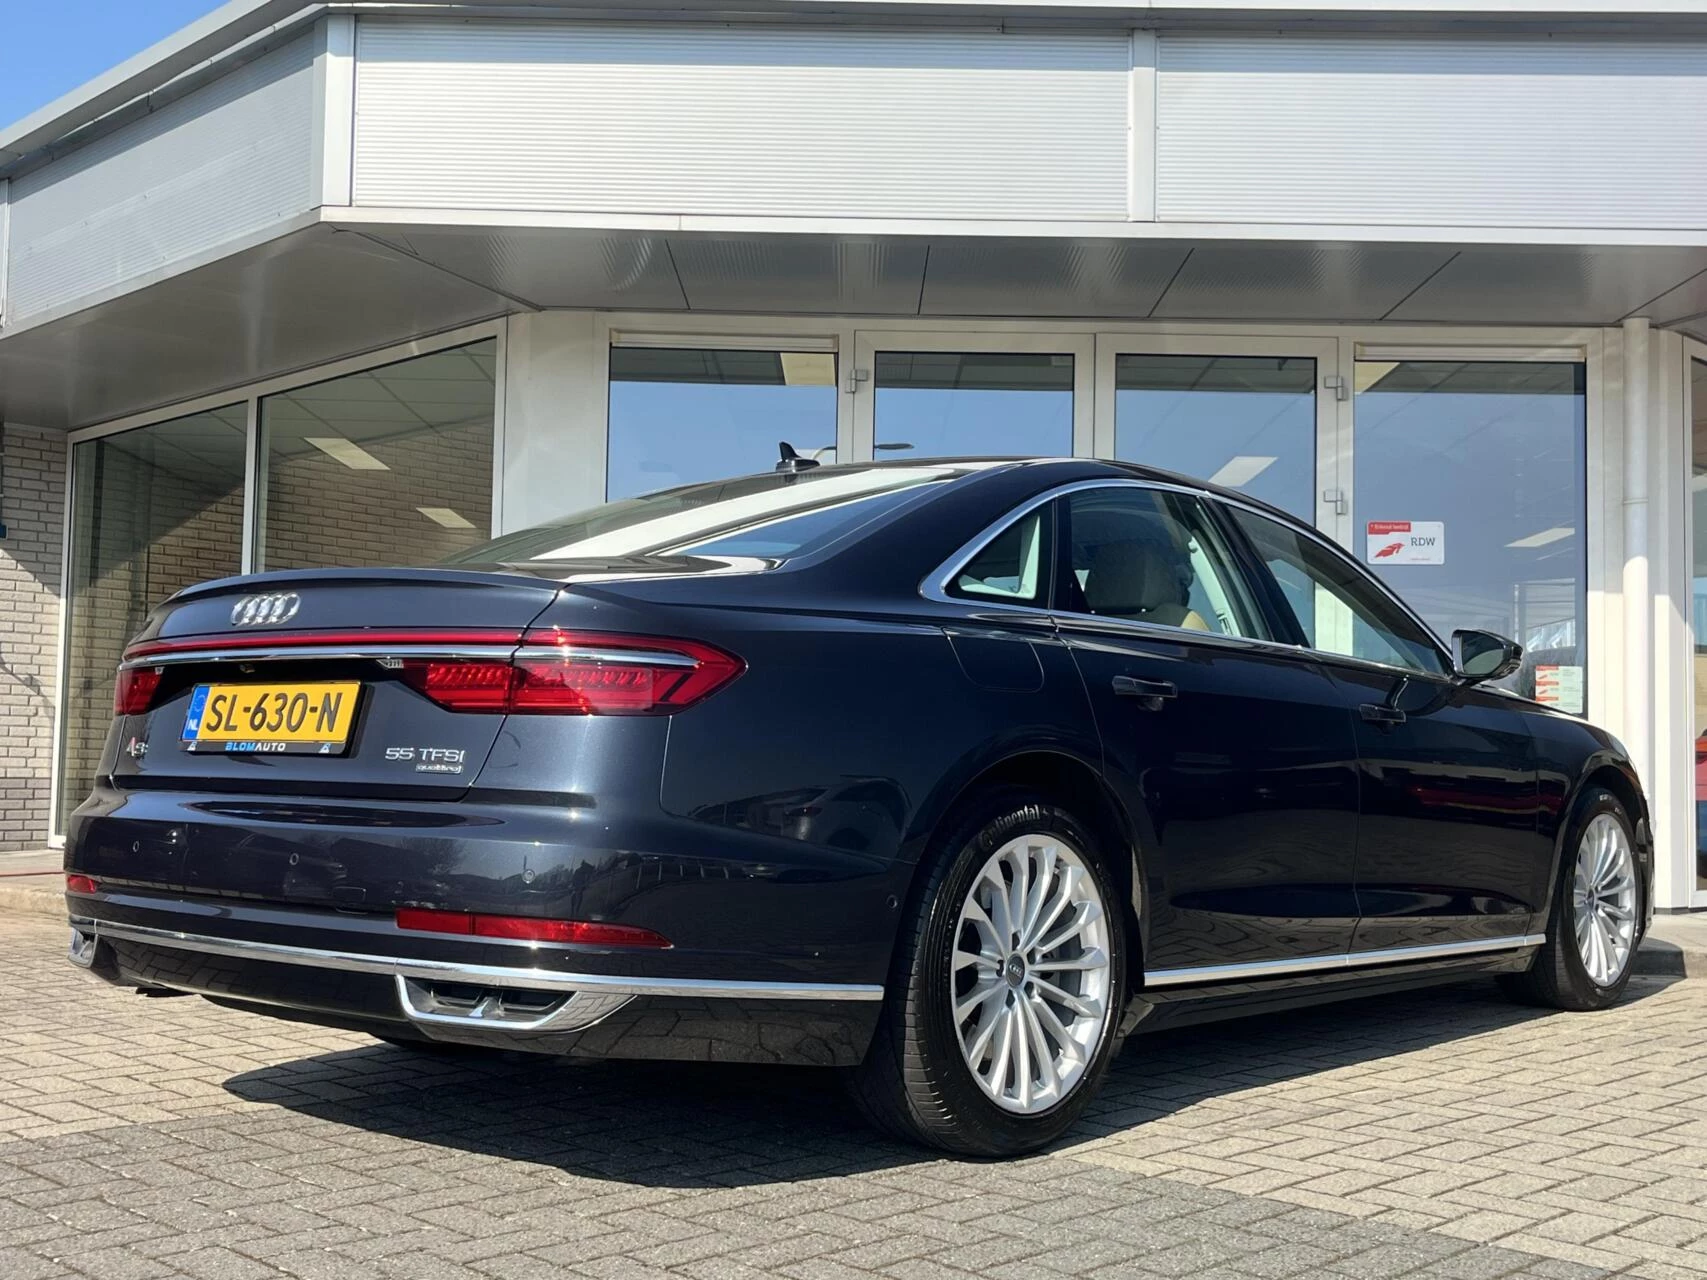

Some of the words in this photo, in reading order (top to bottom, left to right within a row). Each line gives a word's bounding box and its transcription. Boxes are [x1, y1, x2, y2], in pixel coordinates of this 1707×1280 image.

[1411, 537, 1436, 547] RDW
[206, 692, 343, 733] SL-630-N
[187, 718, 198, 731] NL
[385, 747, 415, 760] 55
[419, 748, 465, 763] TFSI
